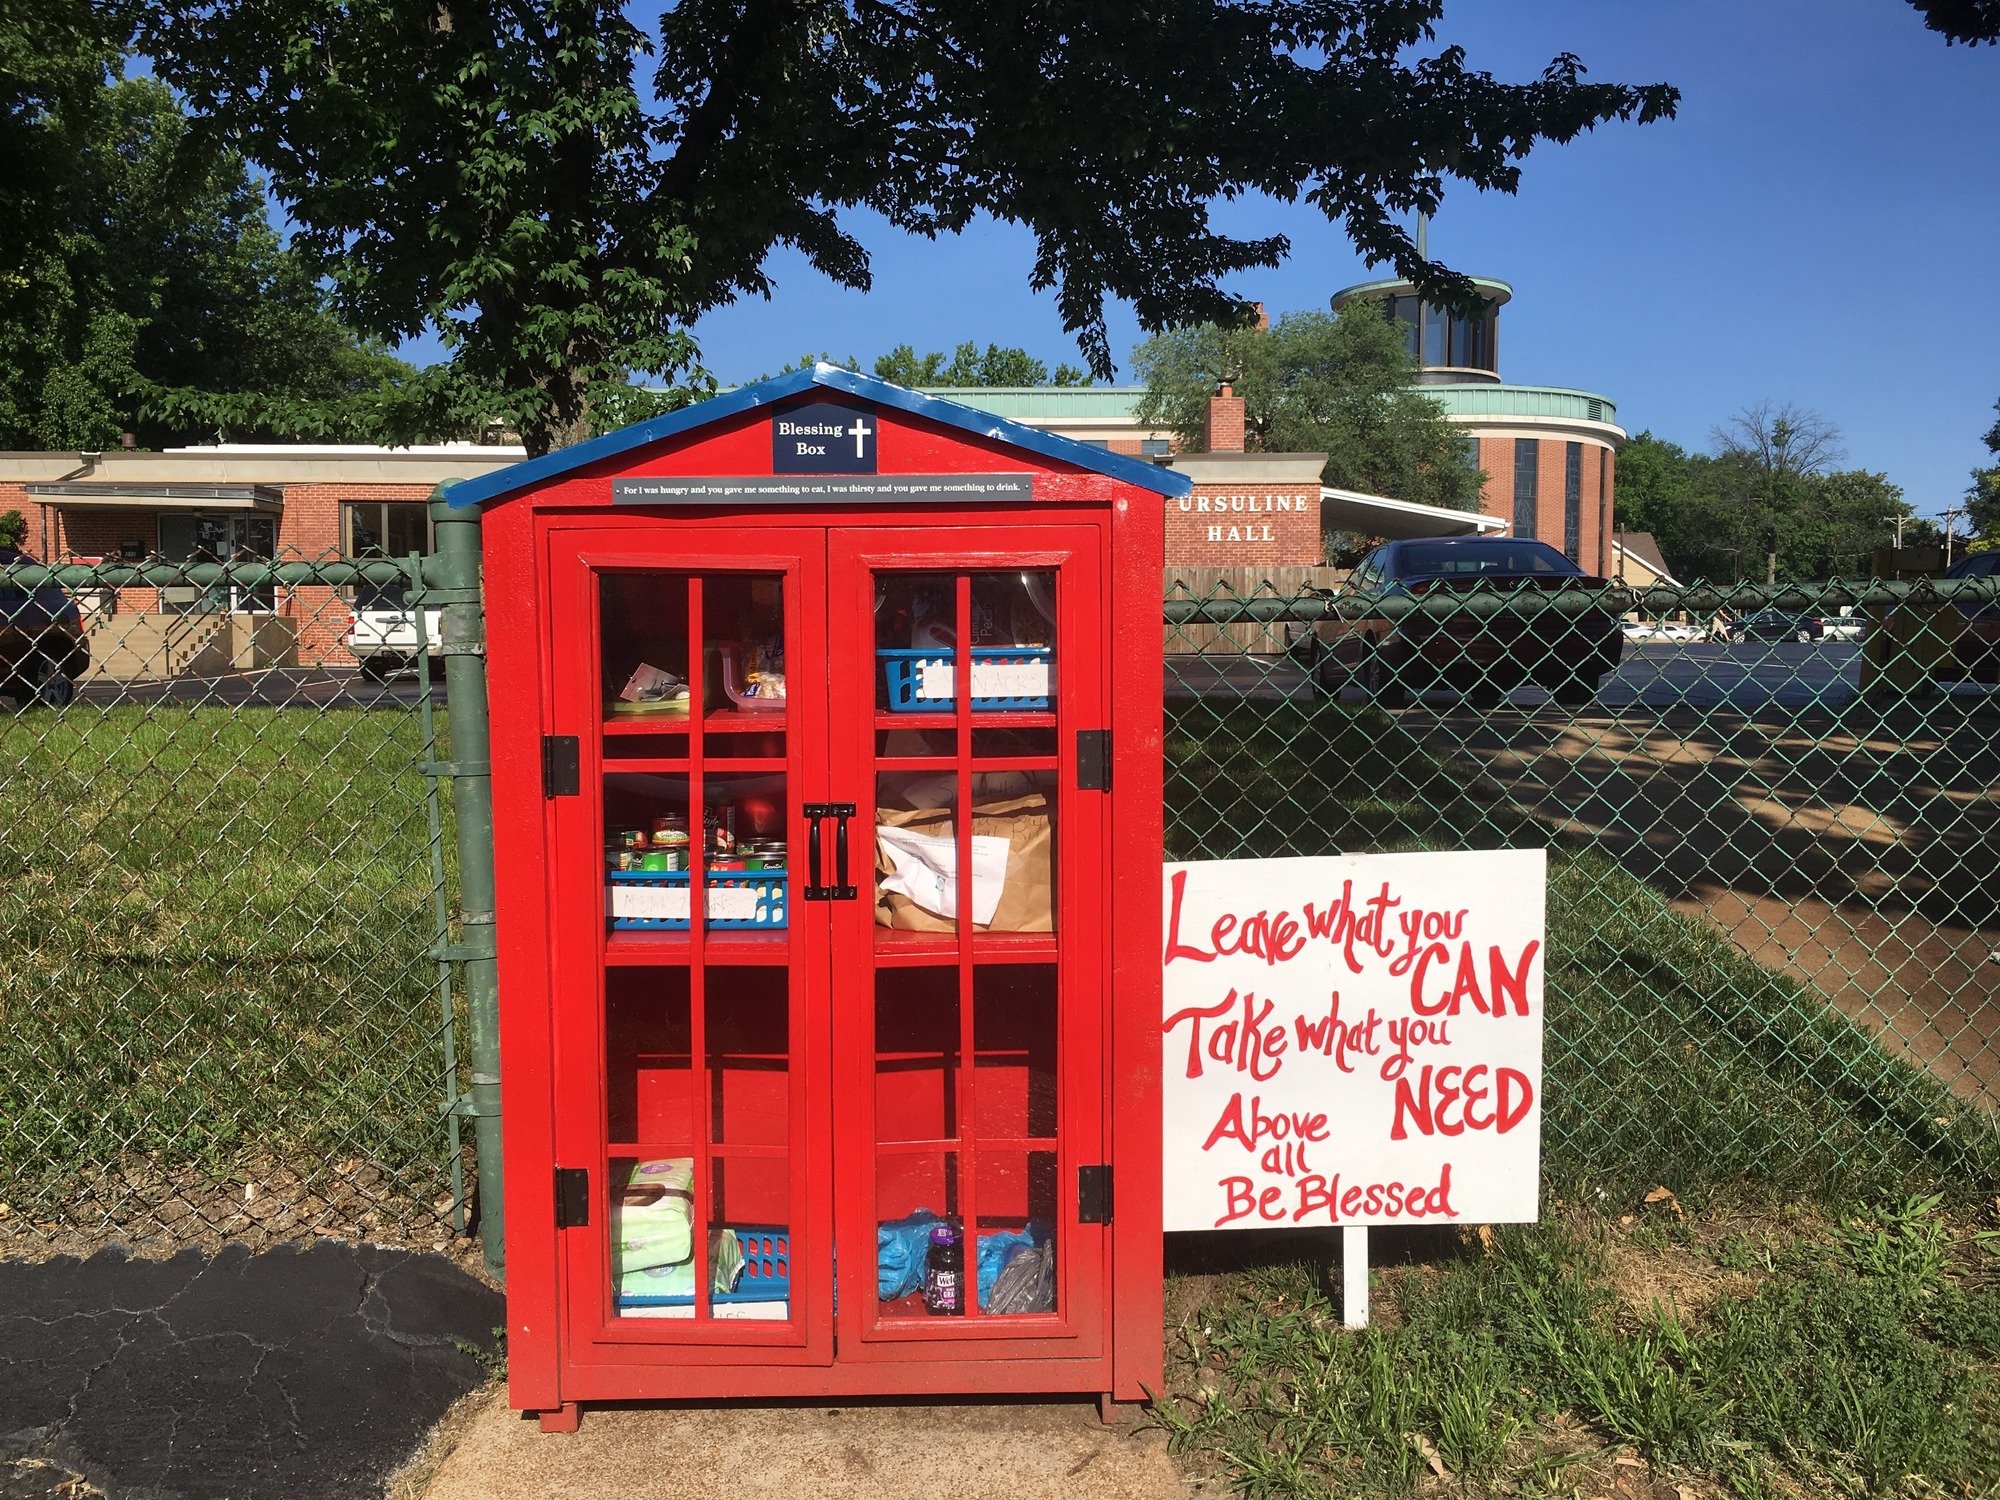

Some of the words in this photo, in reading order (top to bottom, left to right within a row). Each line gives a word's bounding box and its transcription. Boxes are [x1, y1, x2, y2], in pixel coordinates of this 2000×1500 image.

[778, 422, 843, 438] Blessing
[796, 442, 826, 455] Box
[624, 486, 638, 495] For
[644, 487, 659, 495] was
[660, 485, 689, 496] hungry
[690, 485, 706, 494] and
[707, 487, 723, 496] you
[724, 487, 743, 496] gave
[744, 486, 757, 494] me
[758, 484, 801, 496] something
[802, 485, 810, 494] to
[811, 485, 826, 495] eat,
[849, 484, 875, 495] thirsty
[876, 483, 892, 493] and
[893, 485, 909, 494] you
[910, 485, 929, 494] gave
[943, 482, 986, 494] something
[987, 484, 995, 492] to
[996, 482, 1020, 492] drink.
[1178, 496, 1308, 513] URSULINE
[1207, 525, 1275, 542] HALL
[1164, 870, 1306, 966] Leave
[1304, 879, 1401, 974] what
[1389, 909, 1469, 977] you
[1410, 940, 1541, 1018] CAN
[1163, 988, 1288, 1082] Take
[1295, 991, 1382, 1073] what
[1381, 1016, 1452, 1082] you
[1202, 1092, 1331, 1153] Above
[1390, 1064, 1534, 1141] NEED
[1260, 1142, 1312, 1178] all
[1214, 1175, 1287, 1228] Be
[1292, 1163, 1460, 1223] Blessed
